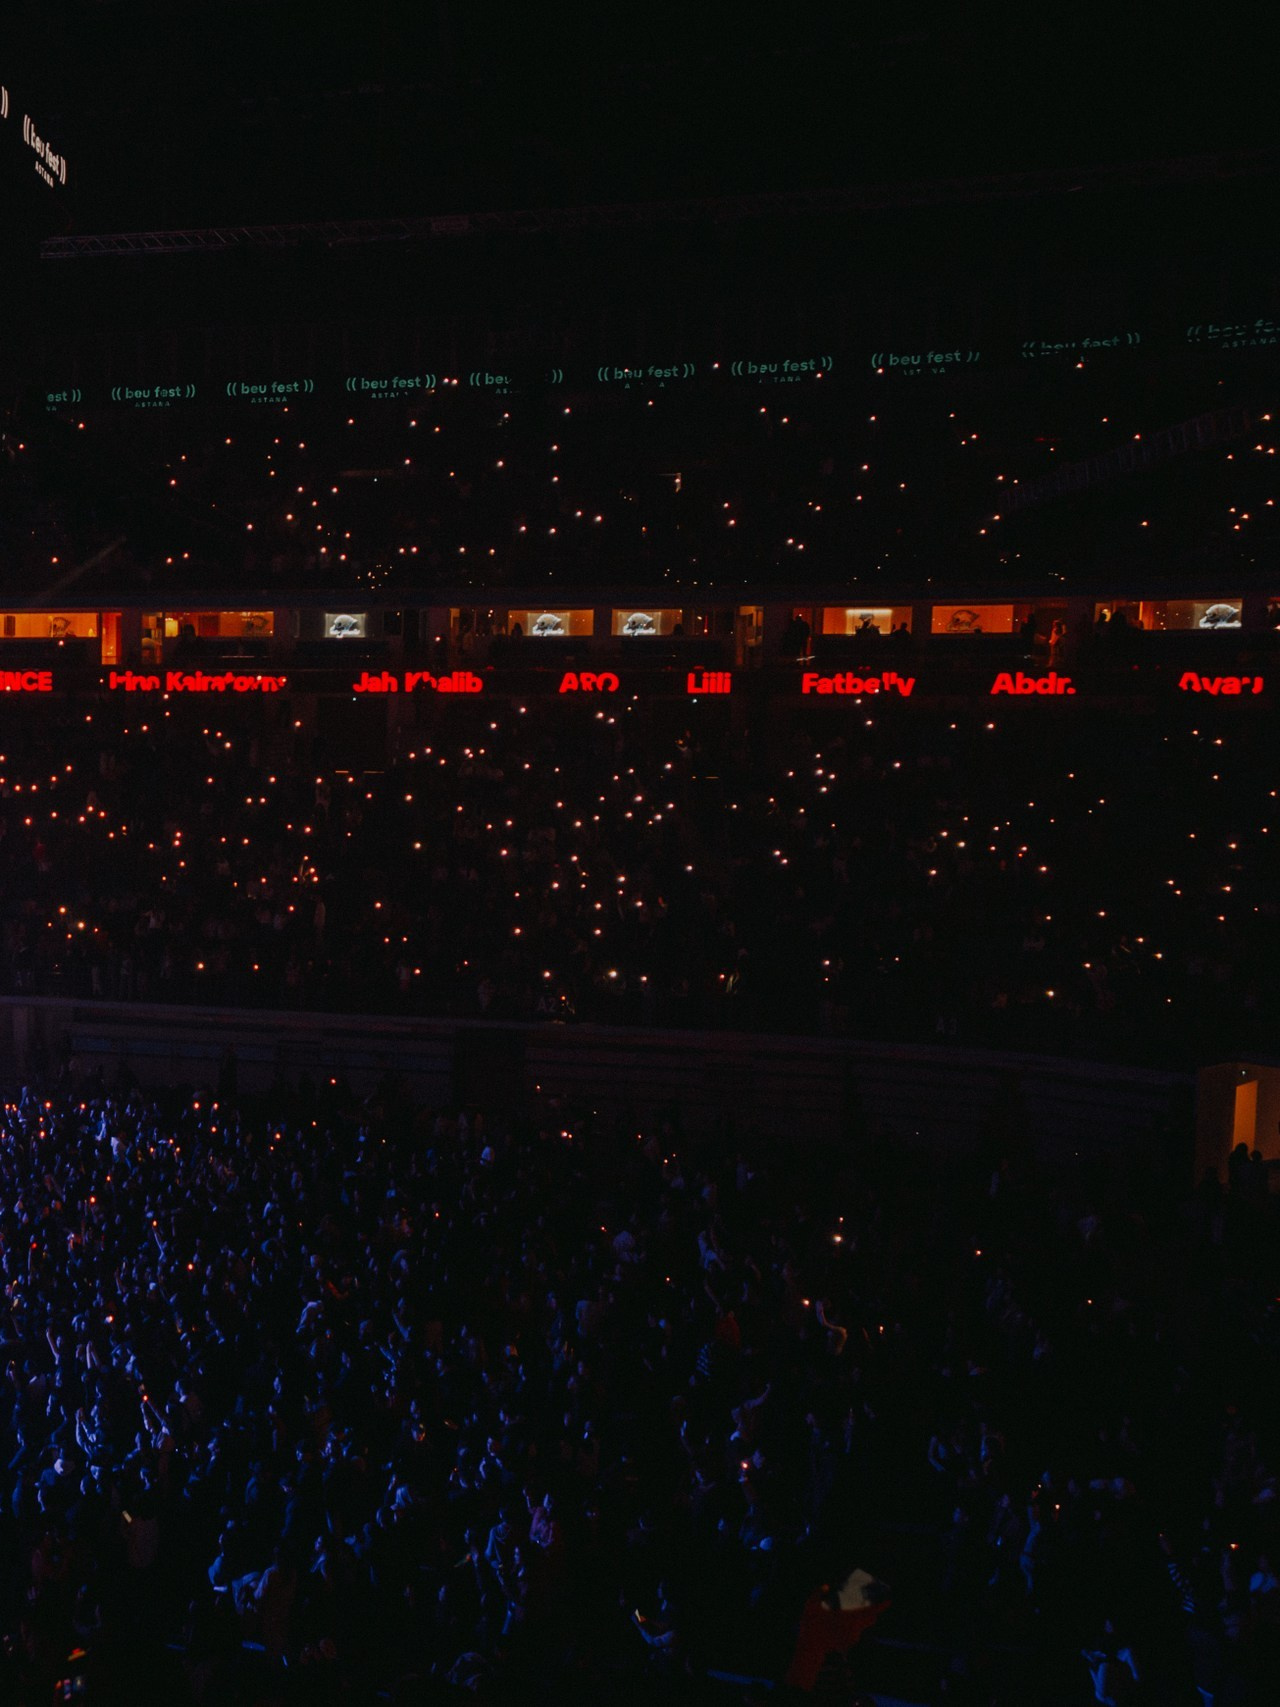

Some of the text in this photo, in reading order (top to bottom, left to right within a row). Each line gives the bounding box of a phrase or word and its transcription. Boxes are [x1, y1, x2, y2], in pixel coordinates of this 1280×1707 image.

[748, 358, 815, 375] beu fest
[889, 350, 961, 367] beu fest
[648, 365, 679, 378] fest
[241, 381, 299, 395] beu fest
[361, 376, 422, 391] beu fest
[125, 387, 151, 400] beu
[352, 671, 398, 693] Jah
[990, 671, 1076, 695] Abdr.
